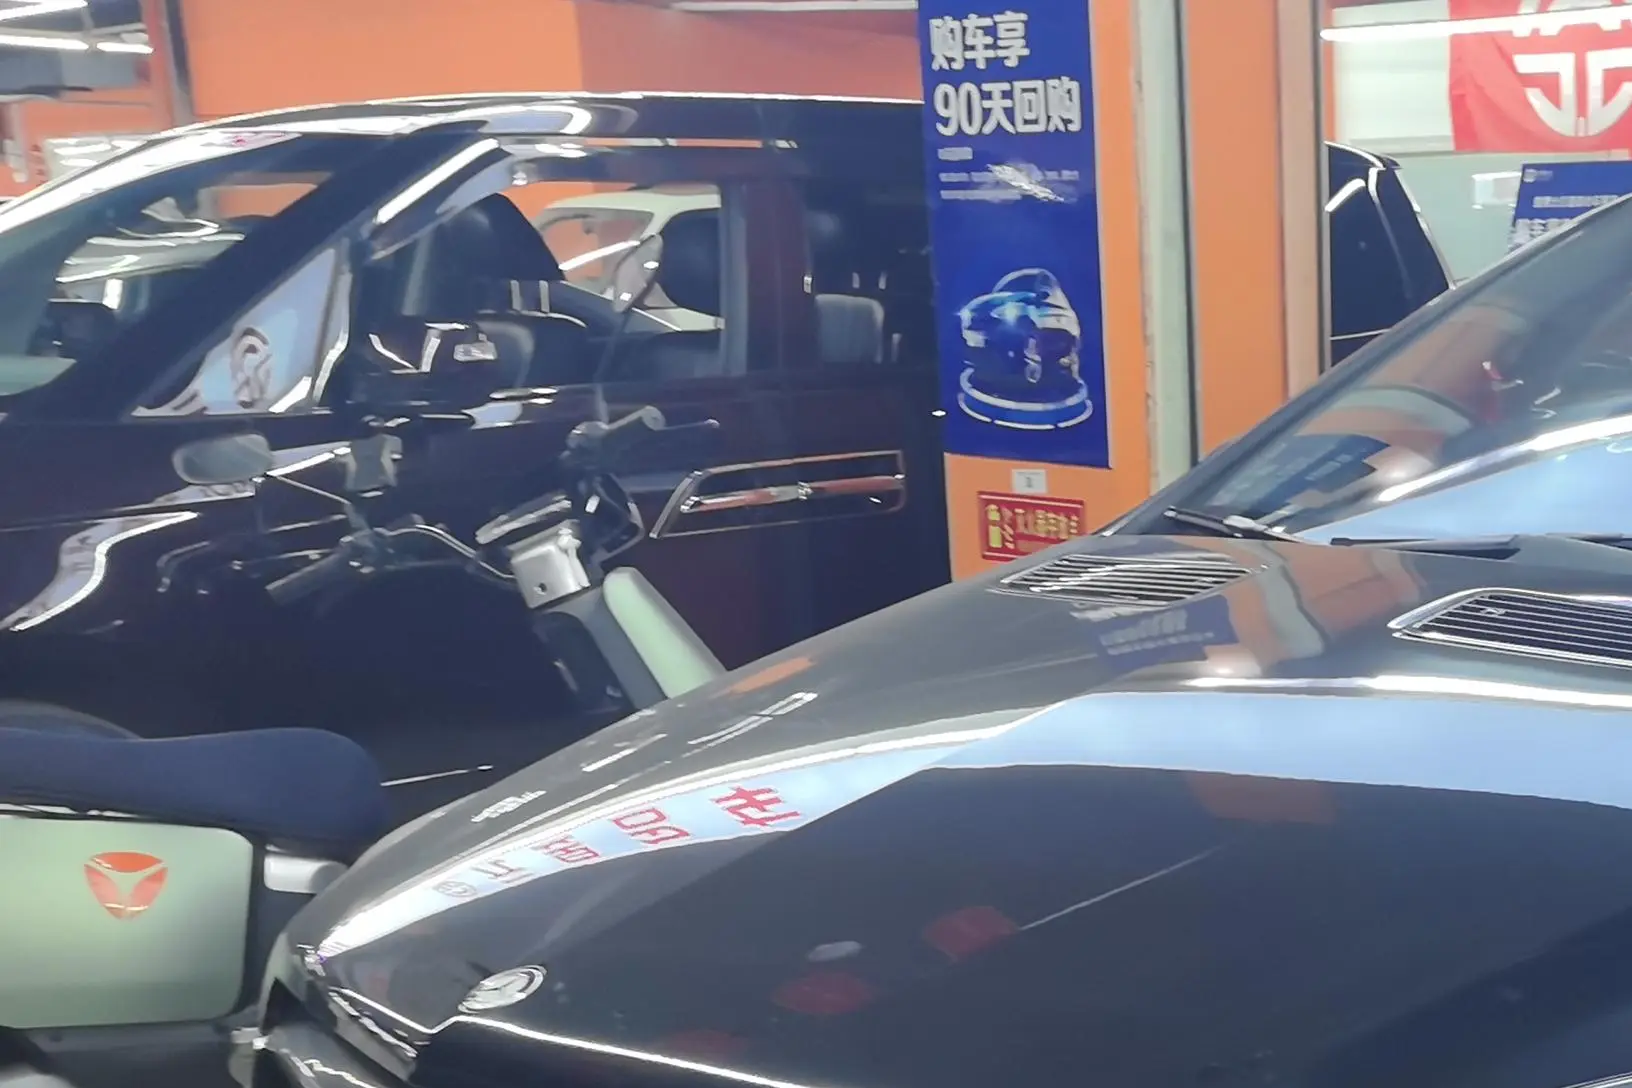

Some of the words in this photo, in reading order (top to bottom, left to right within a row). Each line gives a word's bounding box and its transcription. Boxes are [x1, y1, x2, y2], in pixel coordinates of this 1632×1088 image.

[929, 11, 1030, 71] 购车享
[933, 76, 1082, 136] 90天回购
